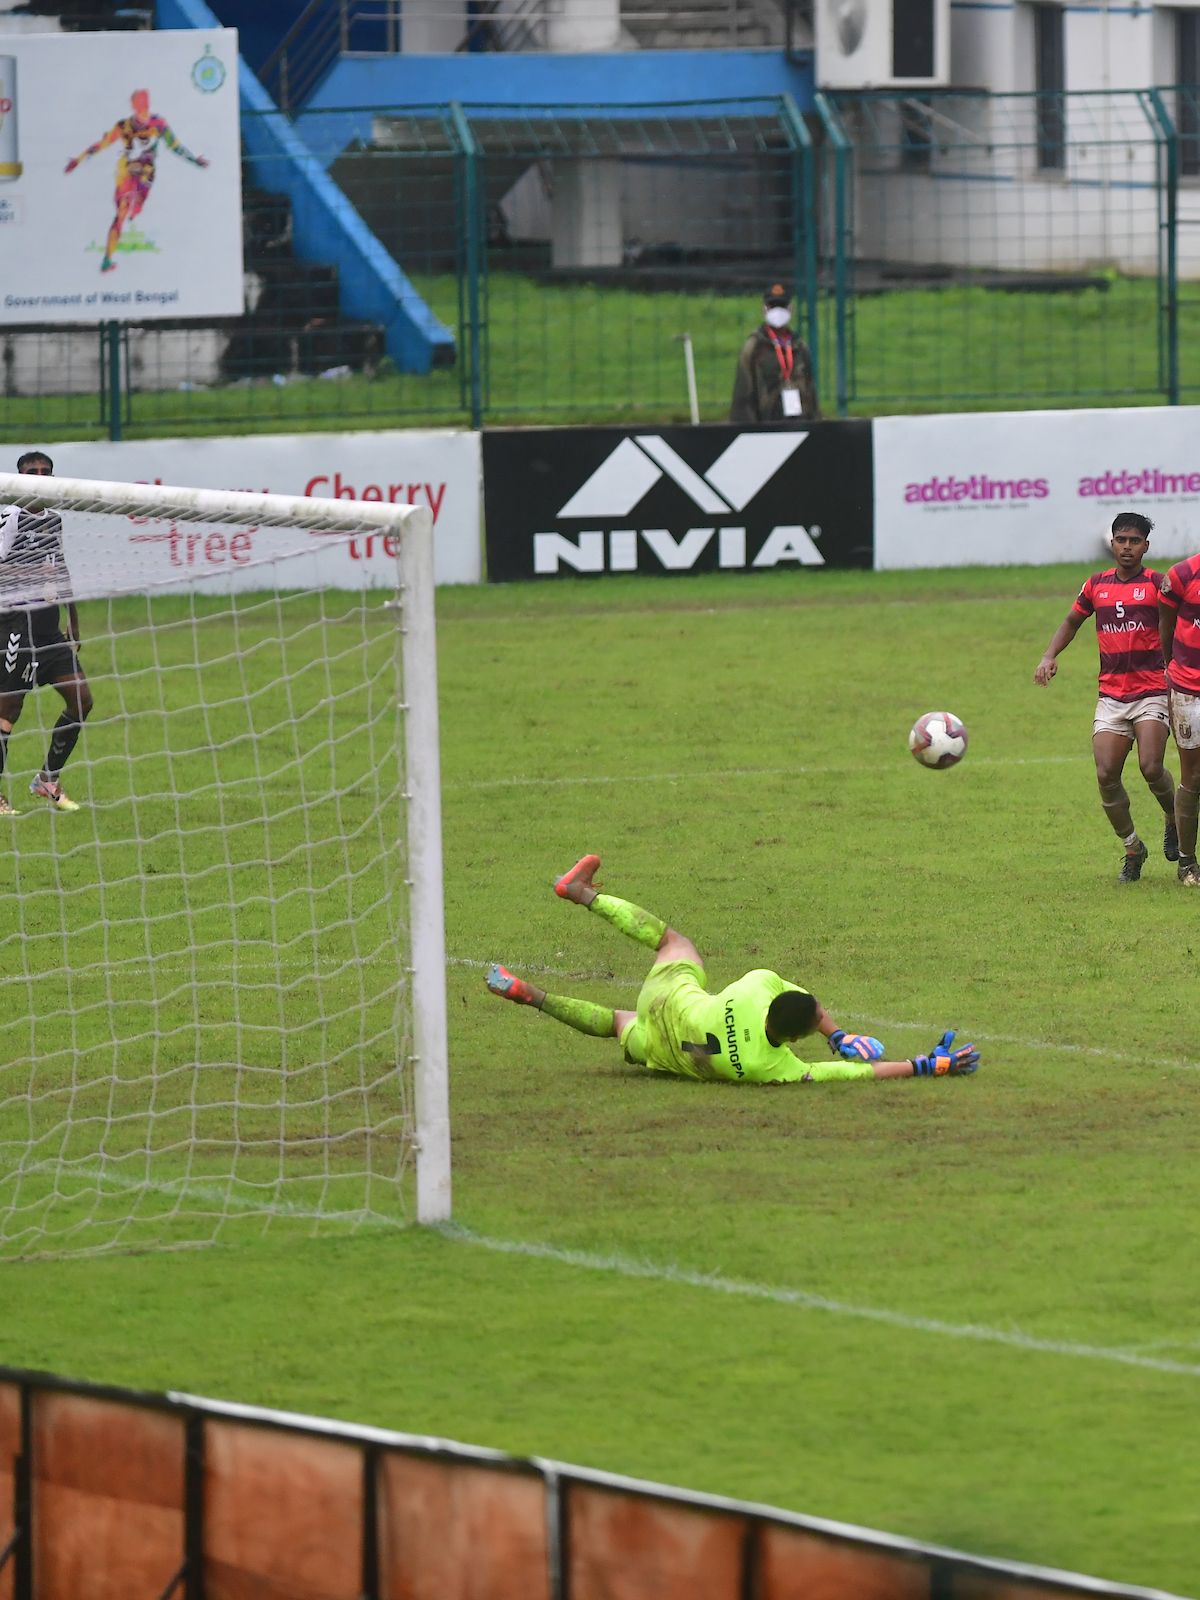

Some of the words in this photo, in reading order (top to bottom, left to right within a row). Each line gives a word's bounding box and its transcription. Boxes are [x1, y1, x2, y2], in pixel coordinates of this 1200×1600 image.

[5, 294, 82, 308] Government
[86, 292, 97, 303] of
[101, 291, 131, 303] West
[135, 289, 179, 305] Bengal
[905, 474, 1050, 502] addatimes
[130, 520, 252, 567] tree
[533, 525, 826, 574] NIVIA
[1115, 600, 1126, 618] 5
[21, 661, 39, 682] 47
[724, 998, 746, 1079] LACHUNGPA
